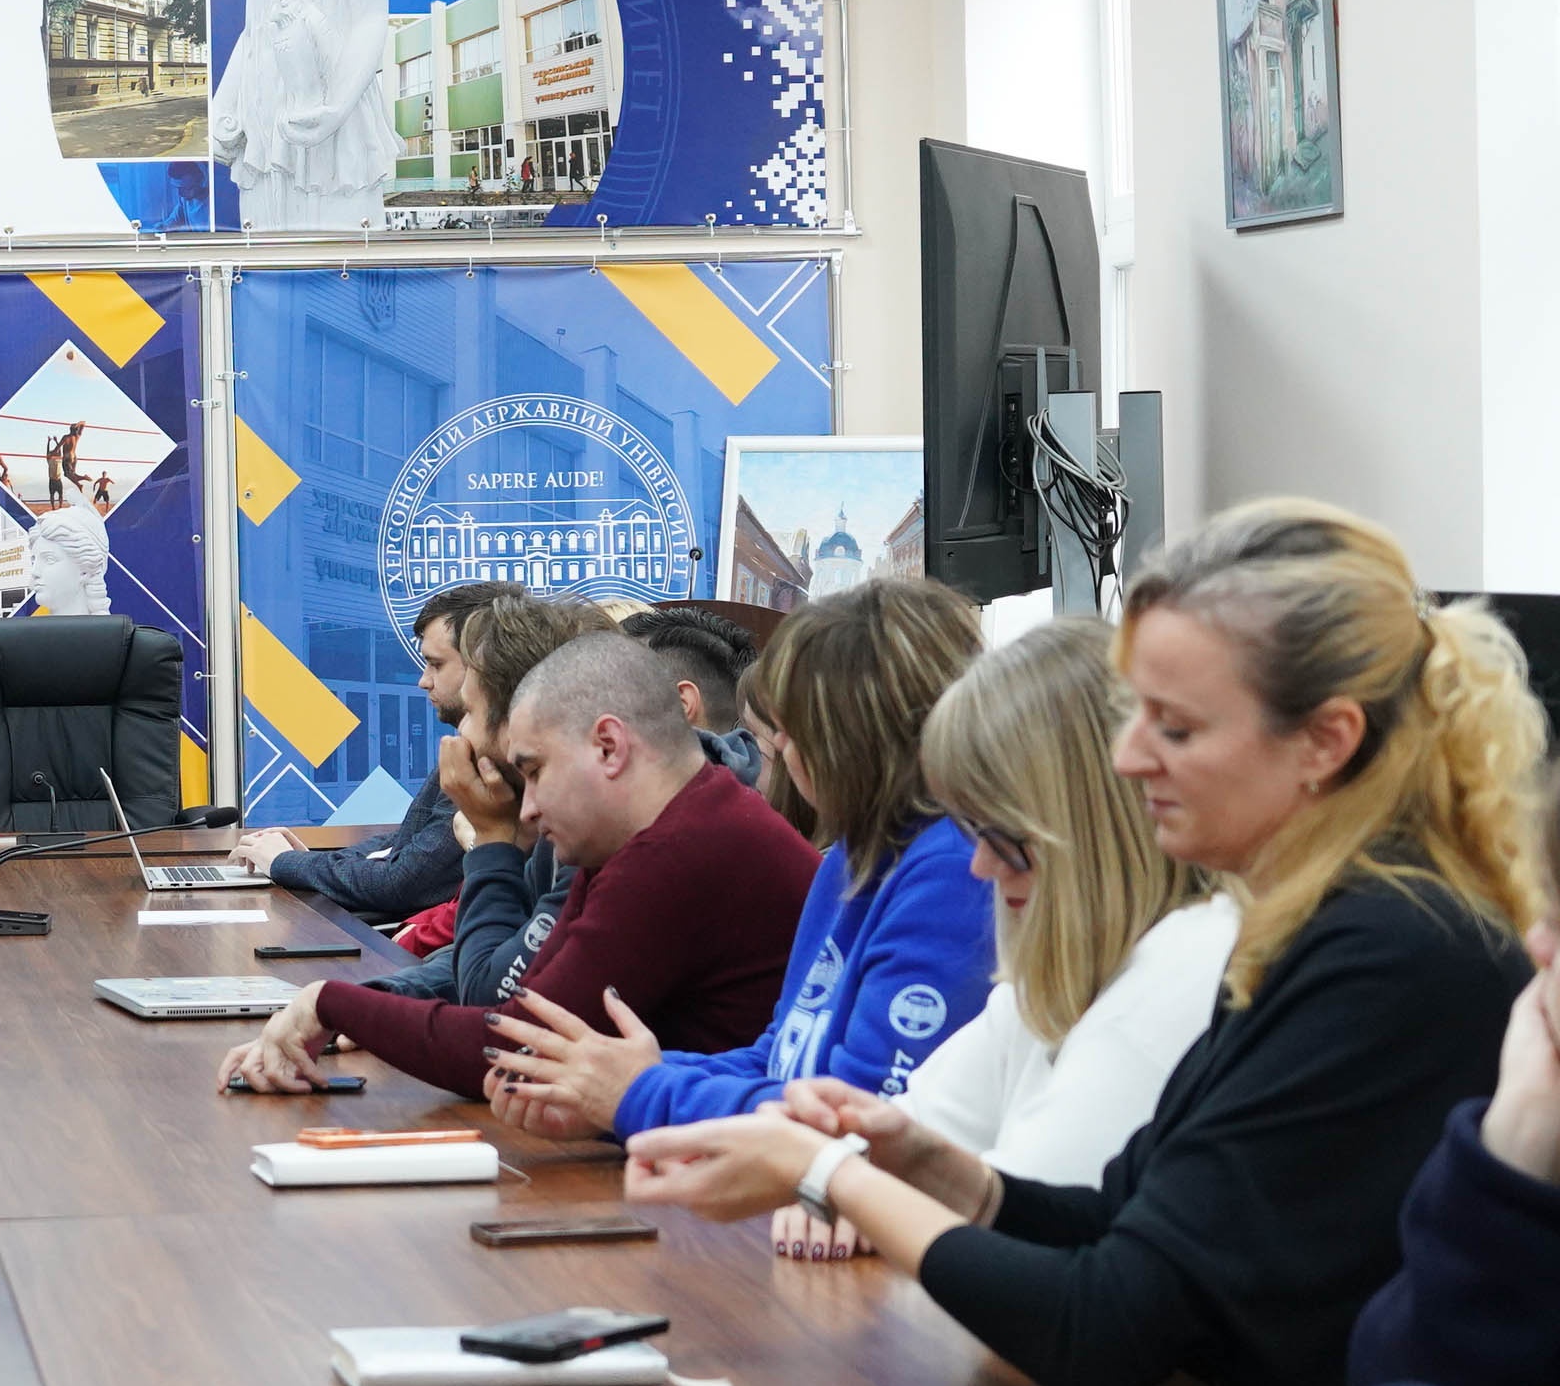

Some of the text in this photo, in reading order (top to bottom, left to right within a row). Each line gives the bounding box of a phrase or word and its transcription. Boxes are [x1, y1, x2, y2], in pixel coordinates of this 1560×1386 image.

[386, 400, 690, 584] ХЕРСОНСЬКИЙ ДЕРЖАВНИЙ УНІВЕРСИТЕТ
[467, 470, 605, 490] SAPERE AUDE!
[496, 954, 528, 1000] 1917
